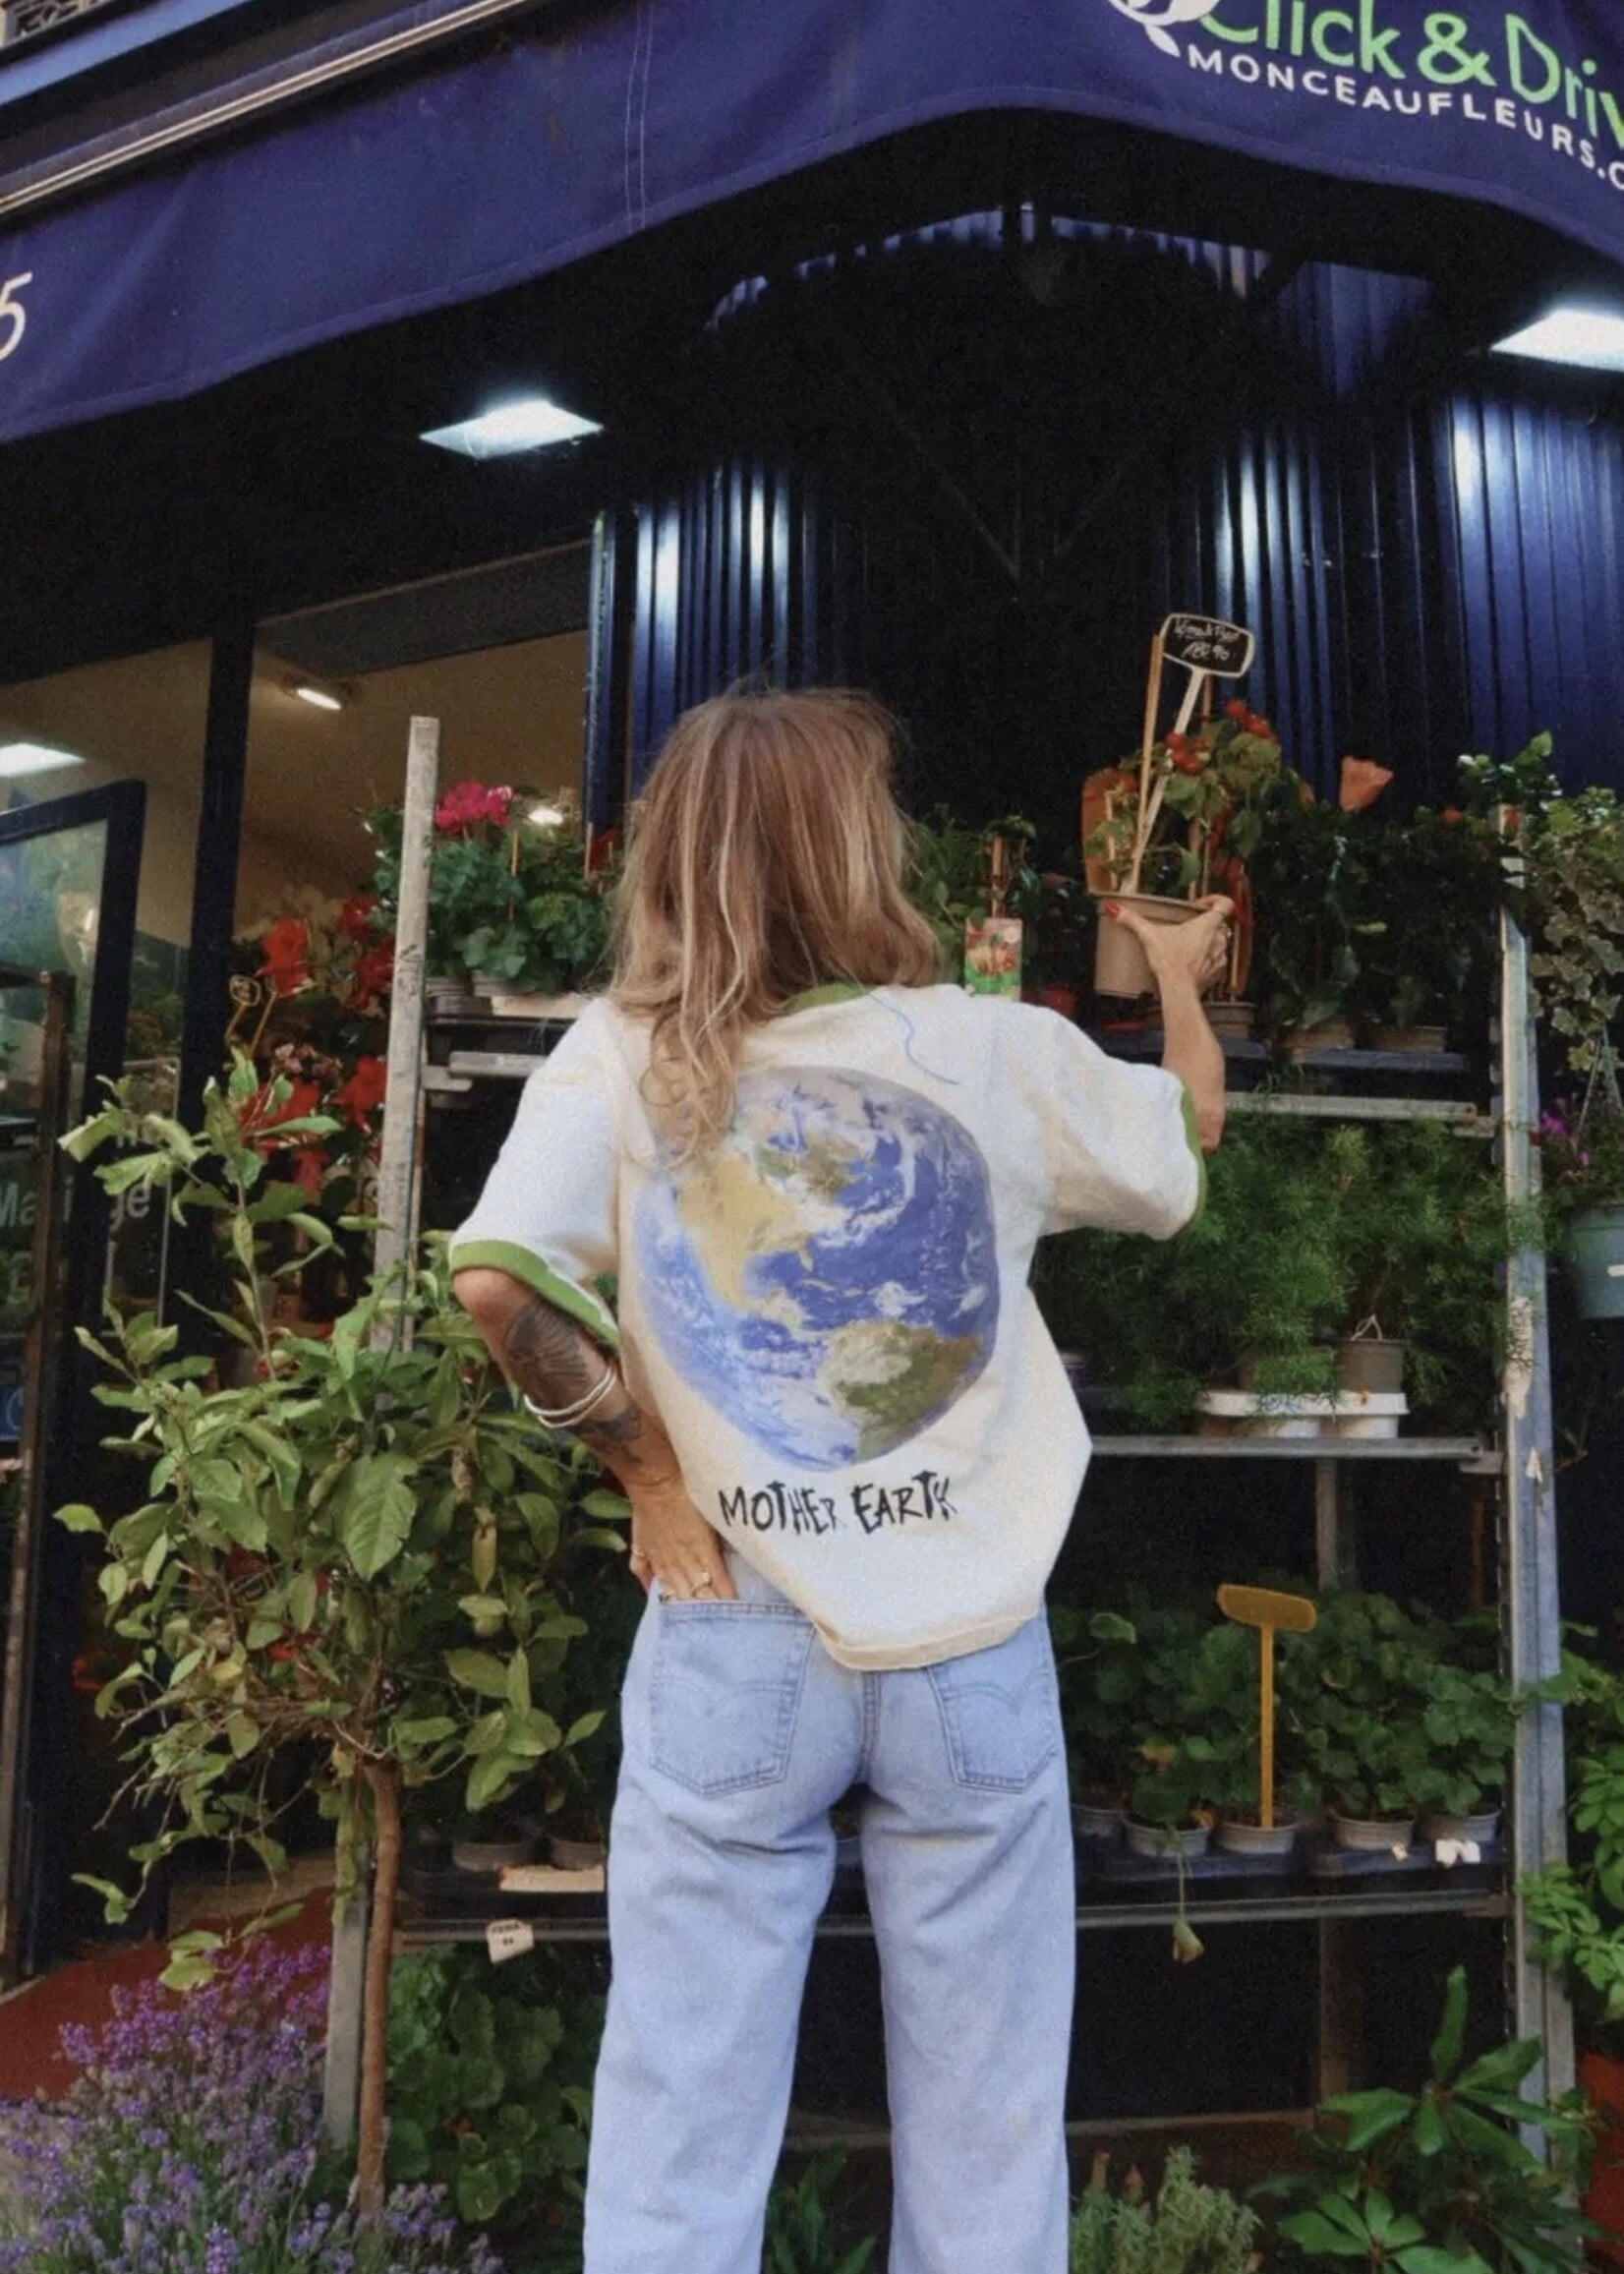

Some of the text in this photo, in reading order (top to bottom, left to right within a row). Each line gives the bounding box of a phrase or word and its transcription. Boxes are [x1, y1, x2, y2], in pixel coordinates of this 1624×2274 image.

[1418, 12, 1497, 87] &
[718, 1470, 958, 1535] MOTHER EARTH
